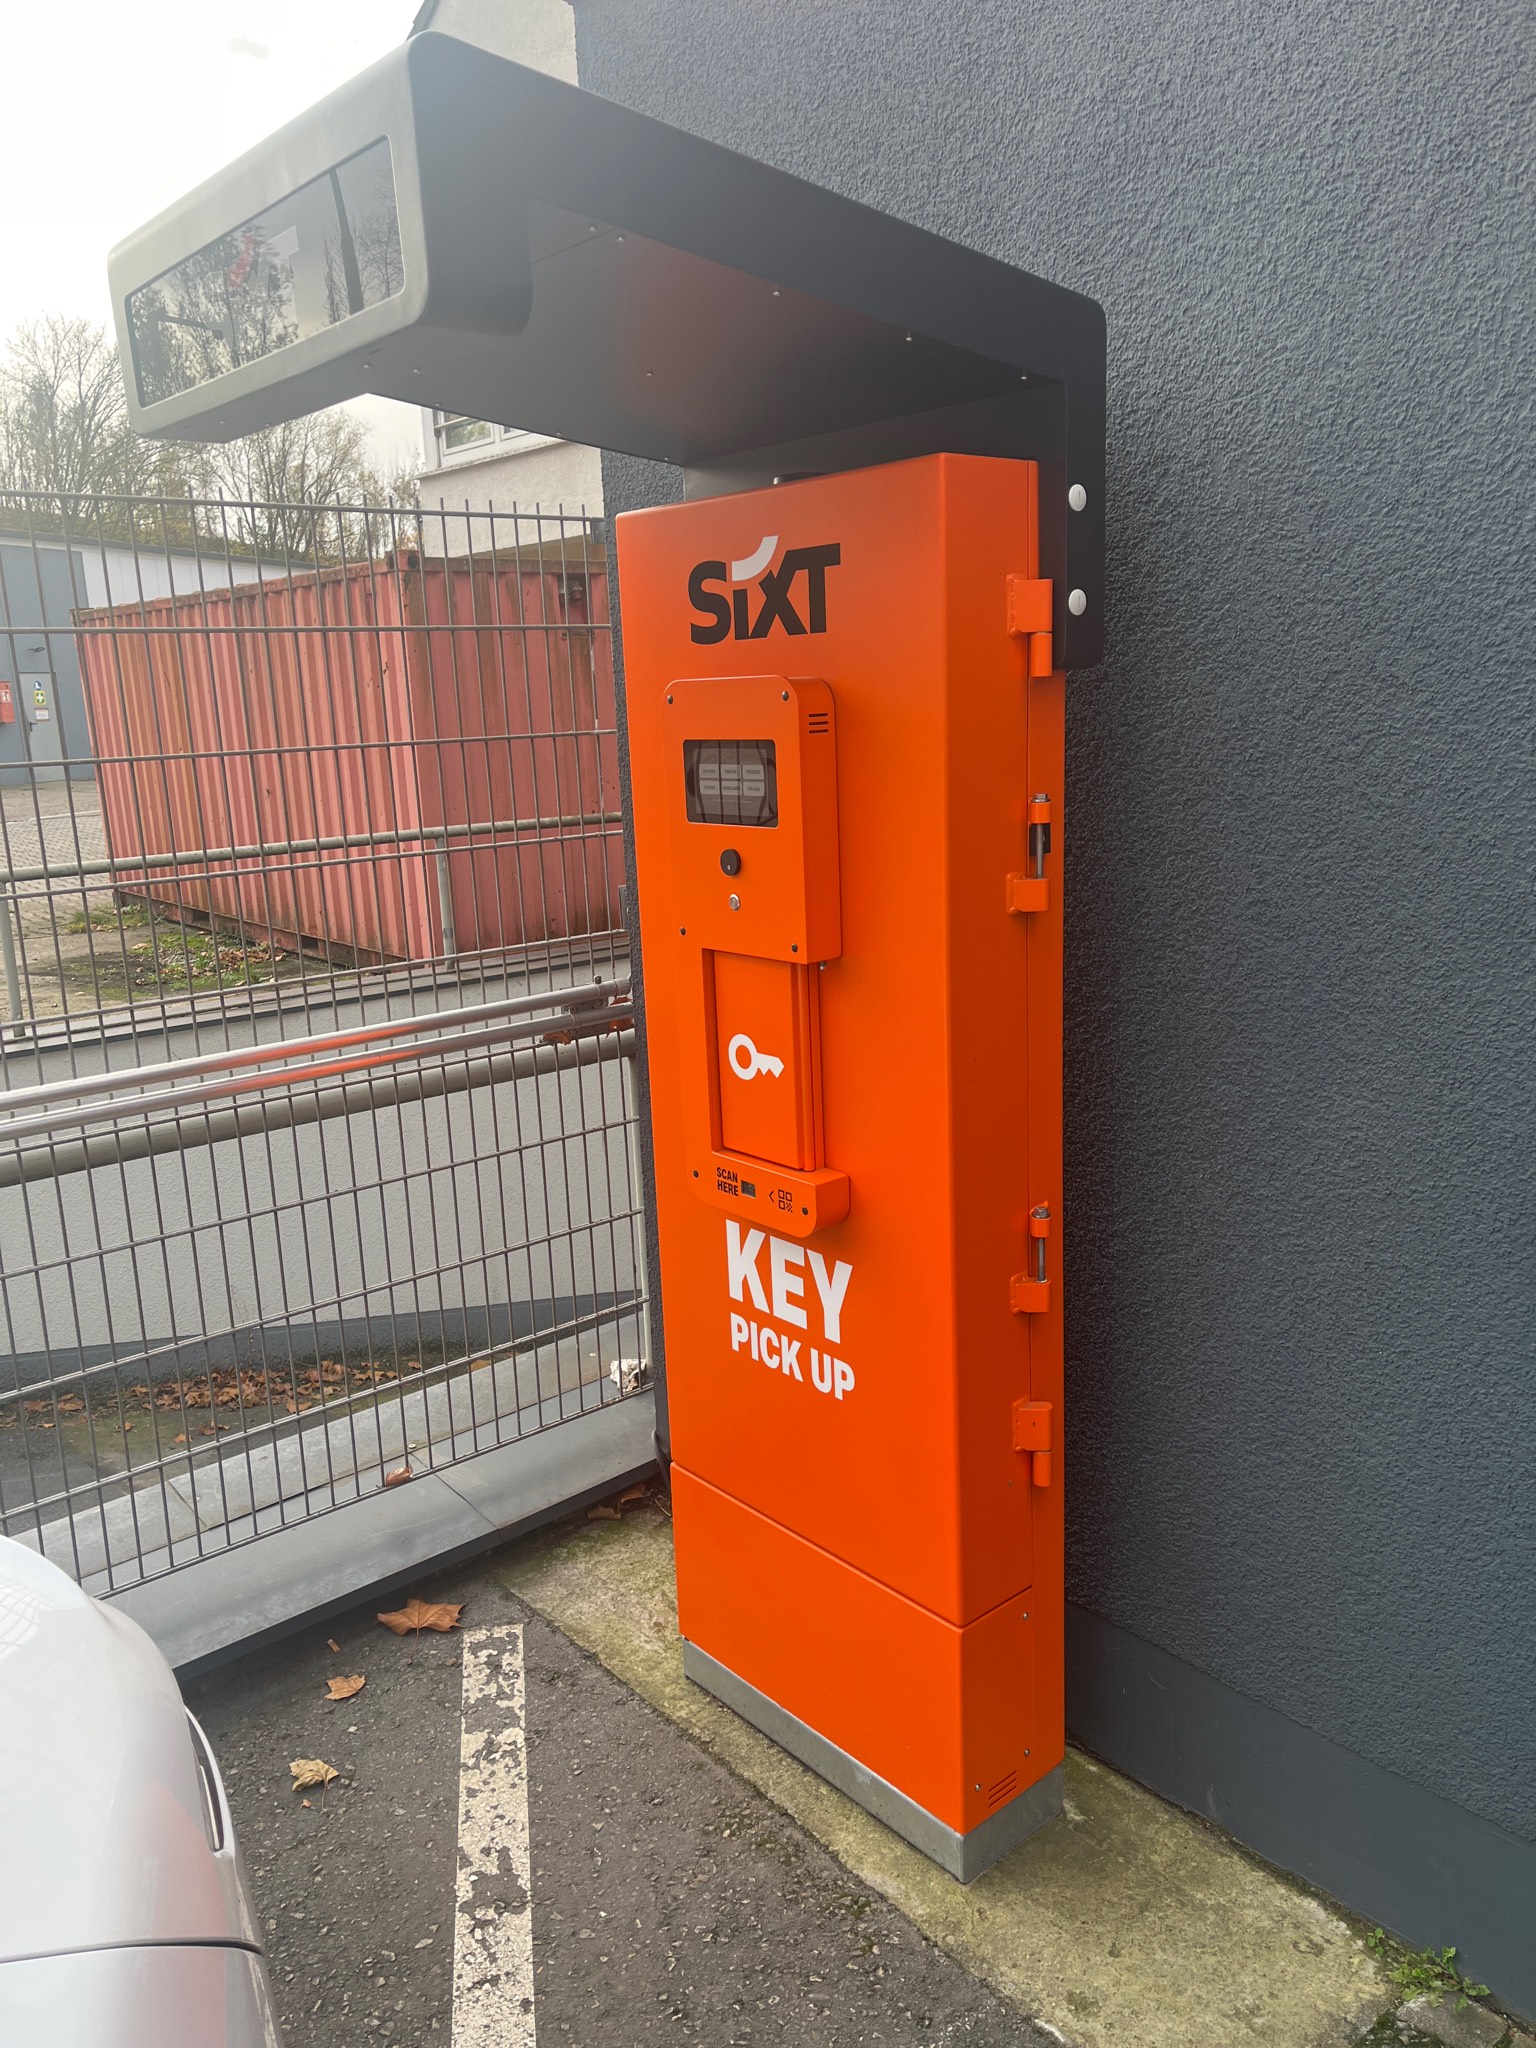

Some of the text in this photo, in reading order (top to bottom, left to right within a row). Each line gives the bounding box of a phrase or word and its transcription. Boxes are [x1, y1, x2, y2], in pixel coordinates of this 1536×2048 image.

[716, 1166, 738, 1184] SCAN
[717, 1179, 739, 1197] HERE
[726, 1219, 853, 1344] KEY
[730, 1312, 855, 1401] PICK UP
